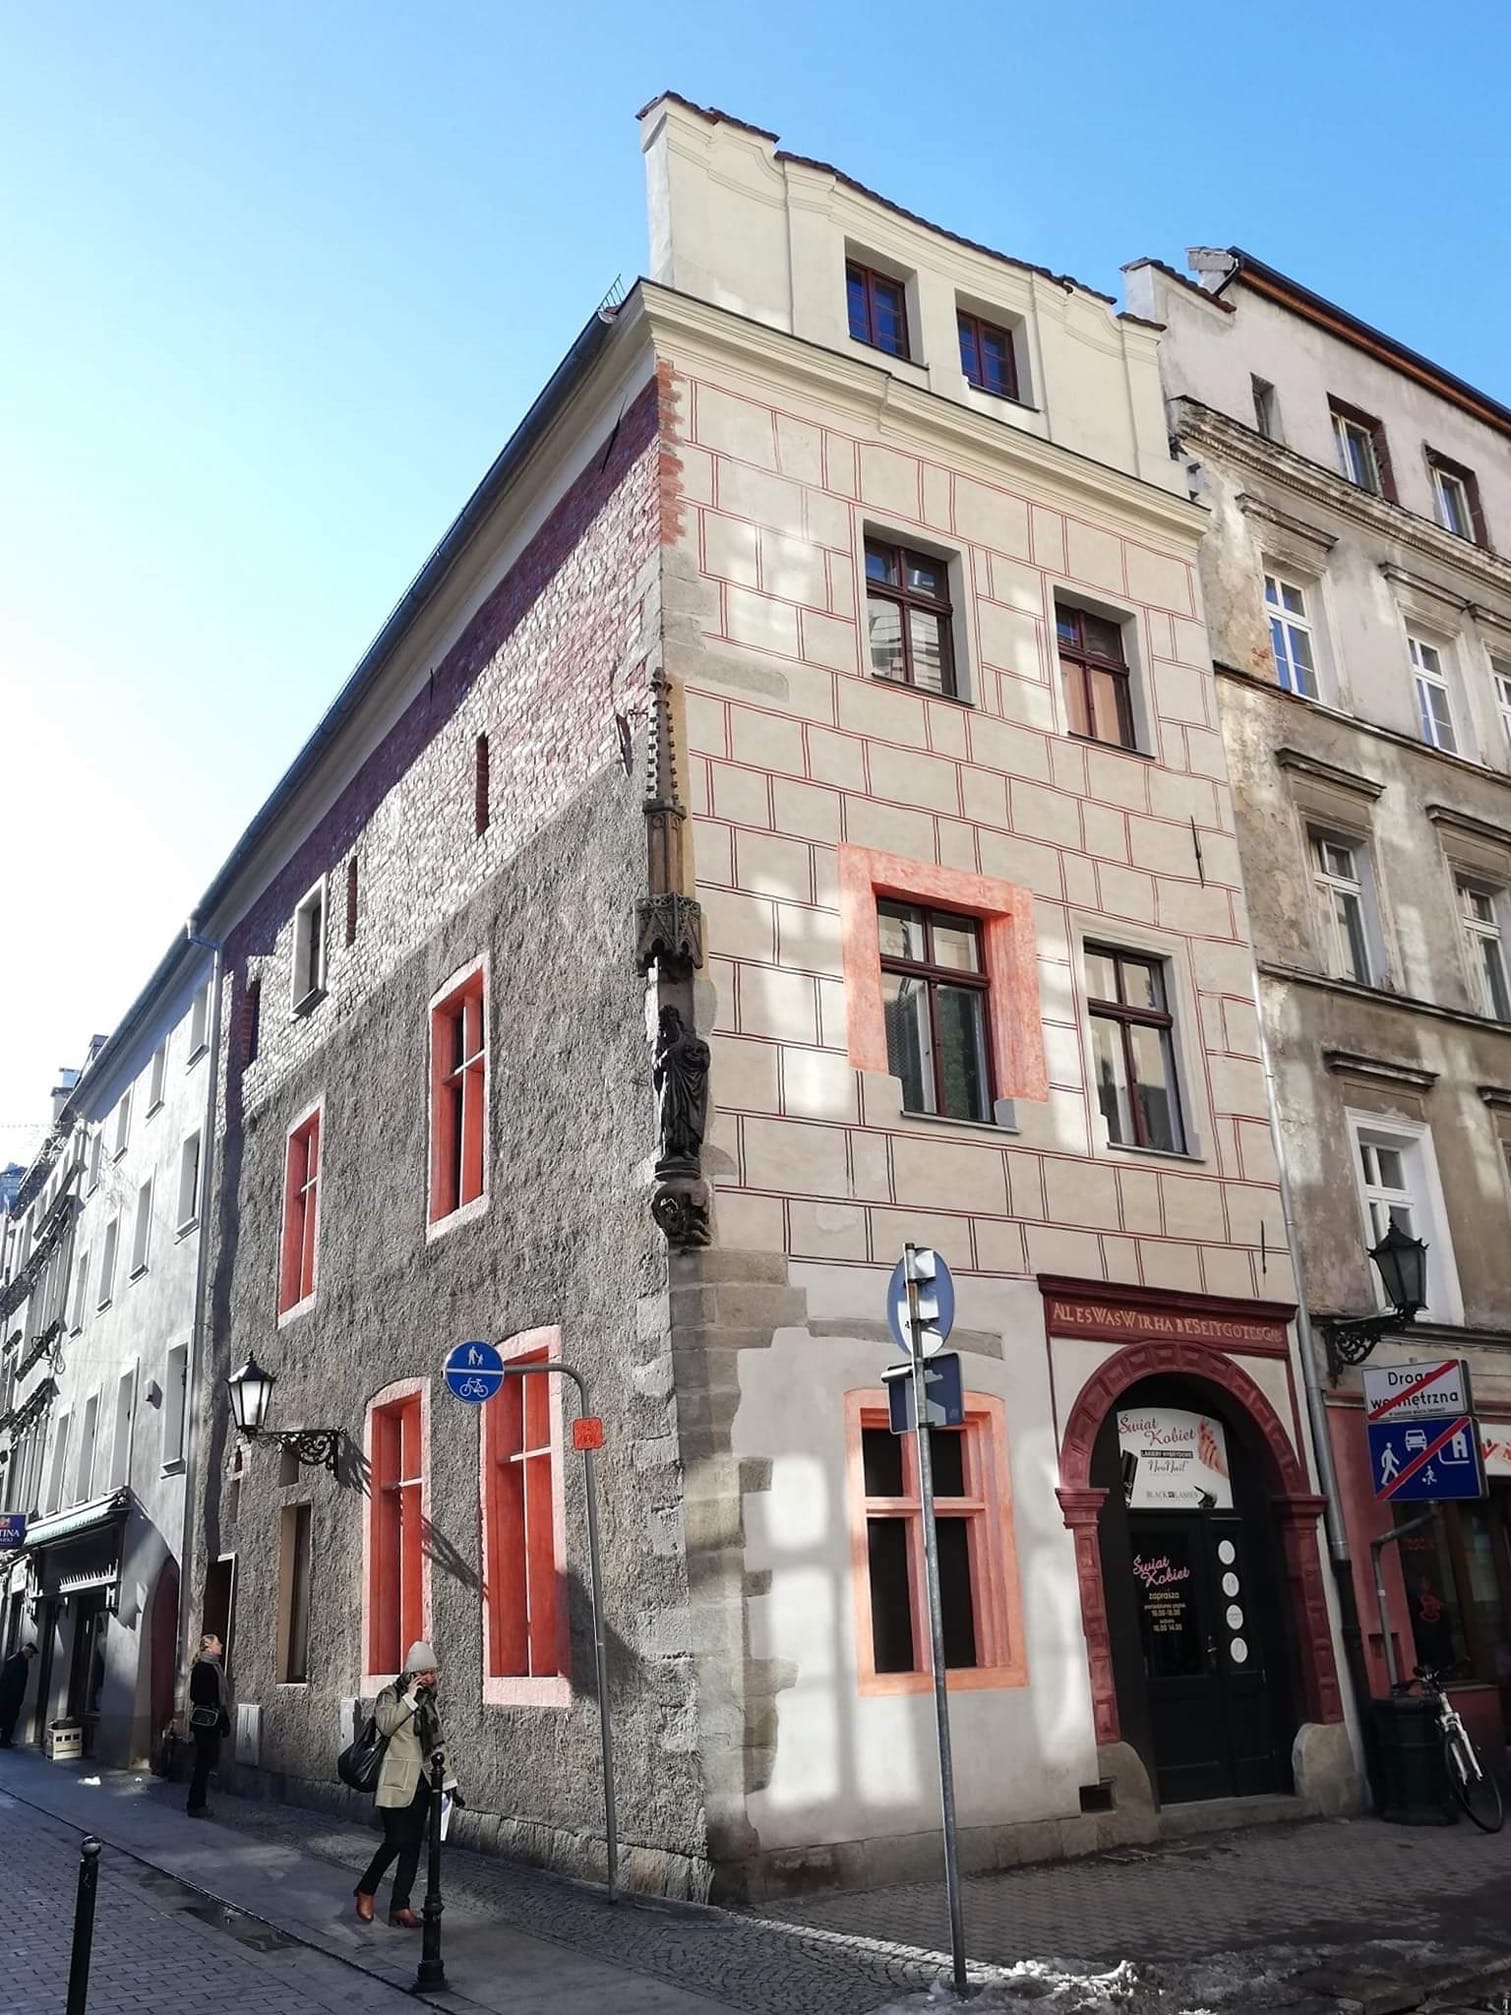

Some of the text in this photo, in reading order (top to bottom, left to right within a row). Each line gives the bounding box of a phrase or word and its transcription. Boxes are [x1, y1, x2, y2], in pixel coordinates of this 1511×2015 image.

[1119, 1414, 1158, 1434] Świat
[1144, 1427, 1195, 1446] Kobiet
[1132, 1554, 1170, 1575] Świat
[1140, 1566, 1190, 1588] Kobiet
